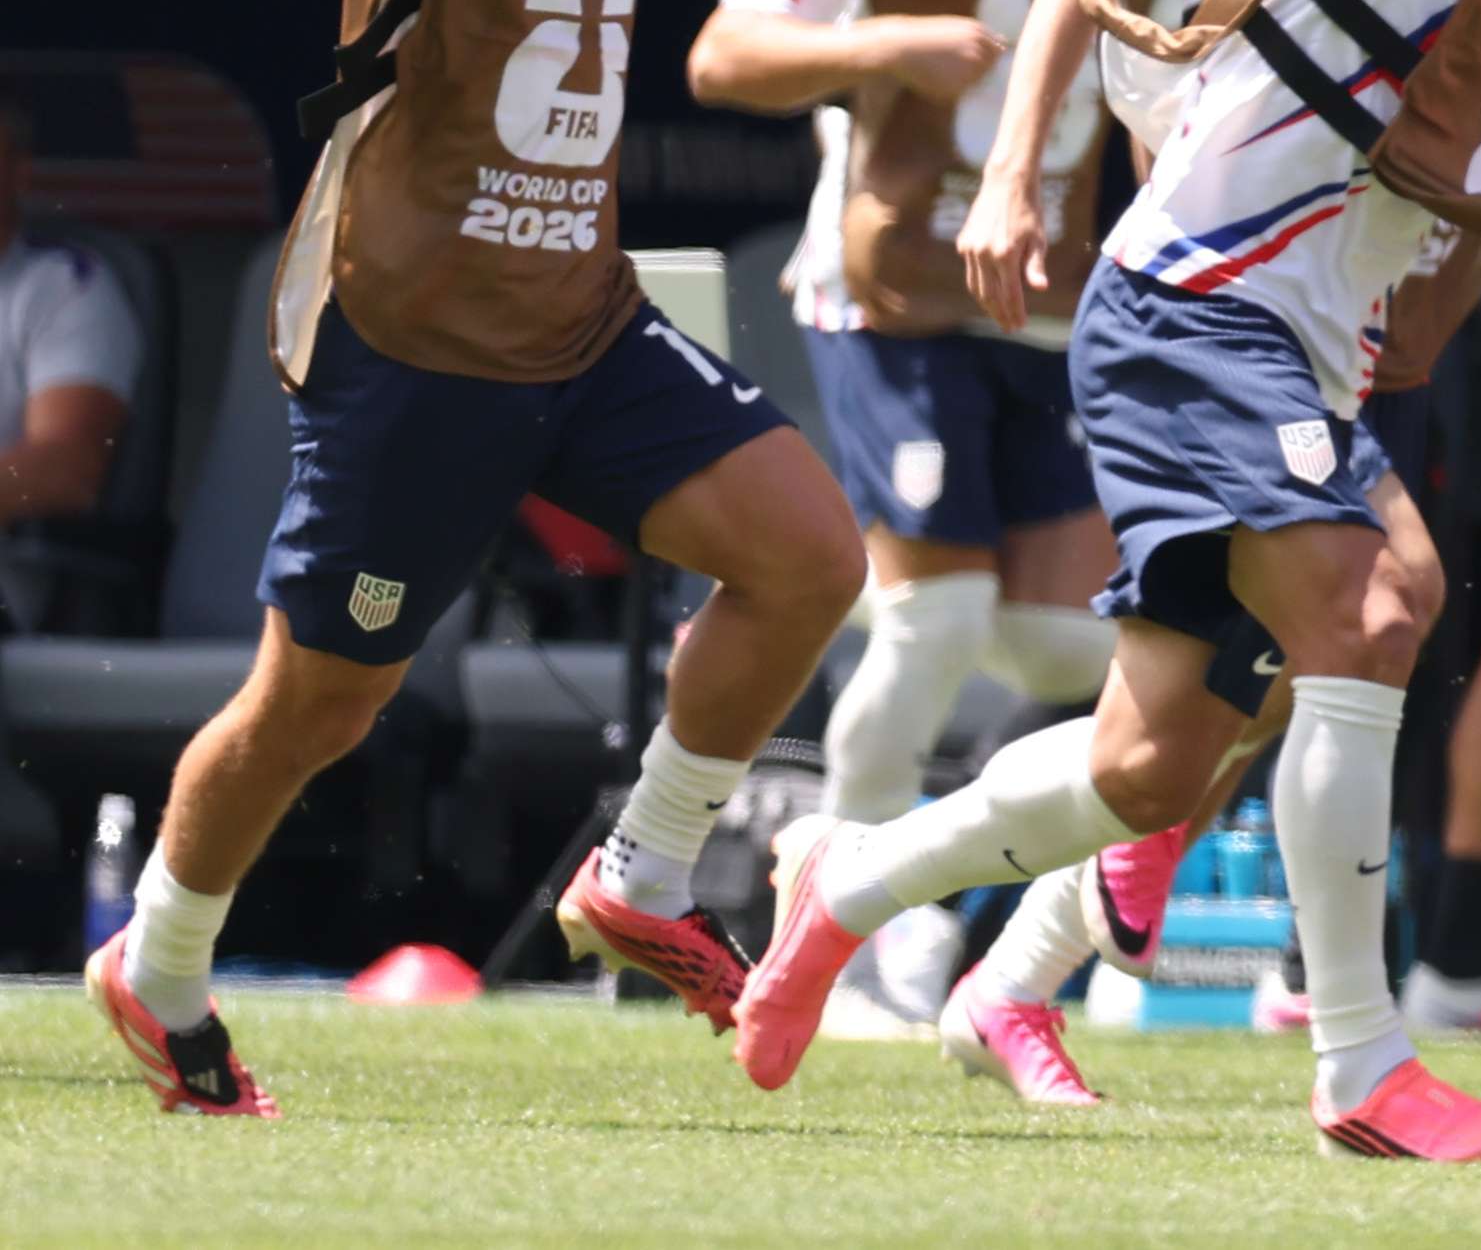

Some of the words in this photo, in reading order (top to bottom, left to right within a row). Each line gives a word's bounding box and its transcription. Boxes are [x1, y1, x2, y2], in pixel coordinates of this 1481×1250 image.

[545, 106, 600, 140] FIFA
[459, 197, 598, 252] 2026
[359, 575, 401, 602] USA
